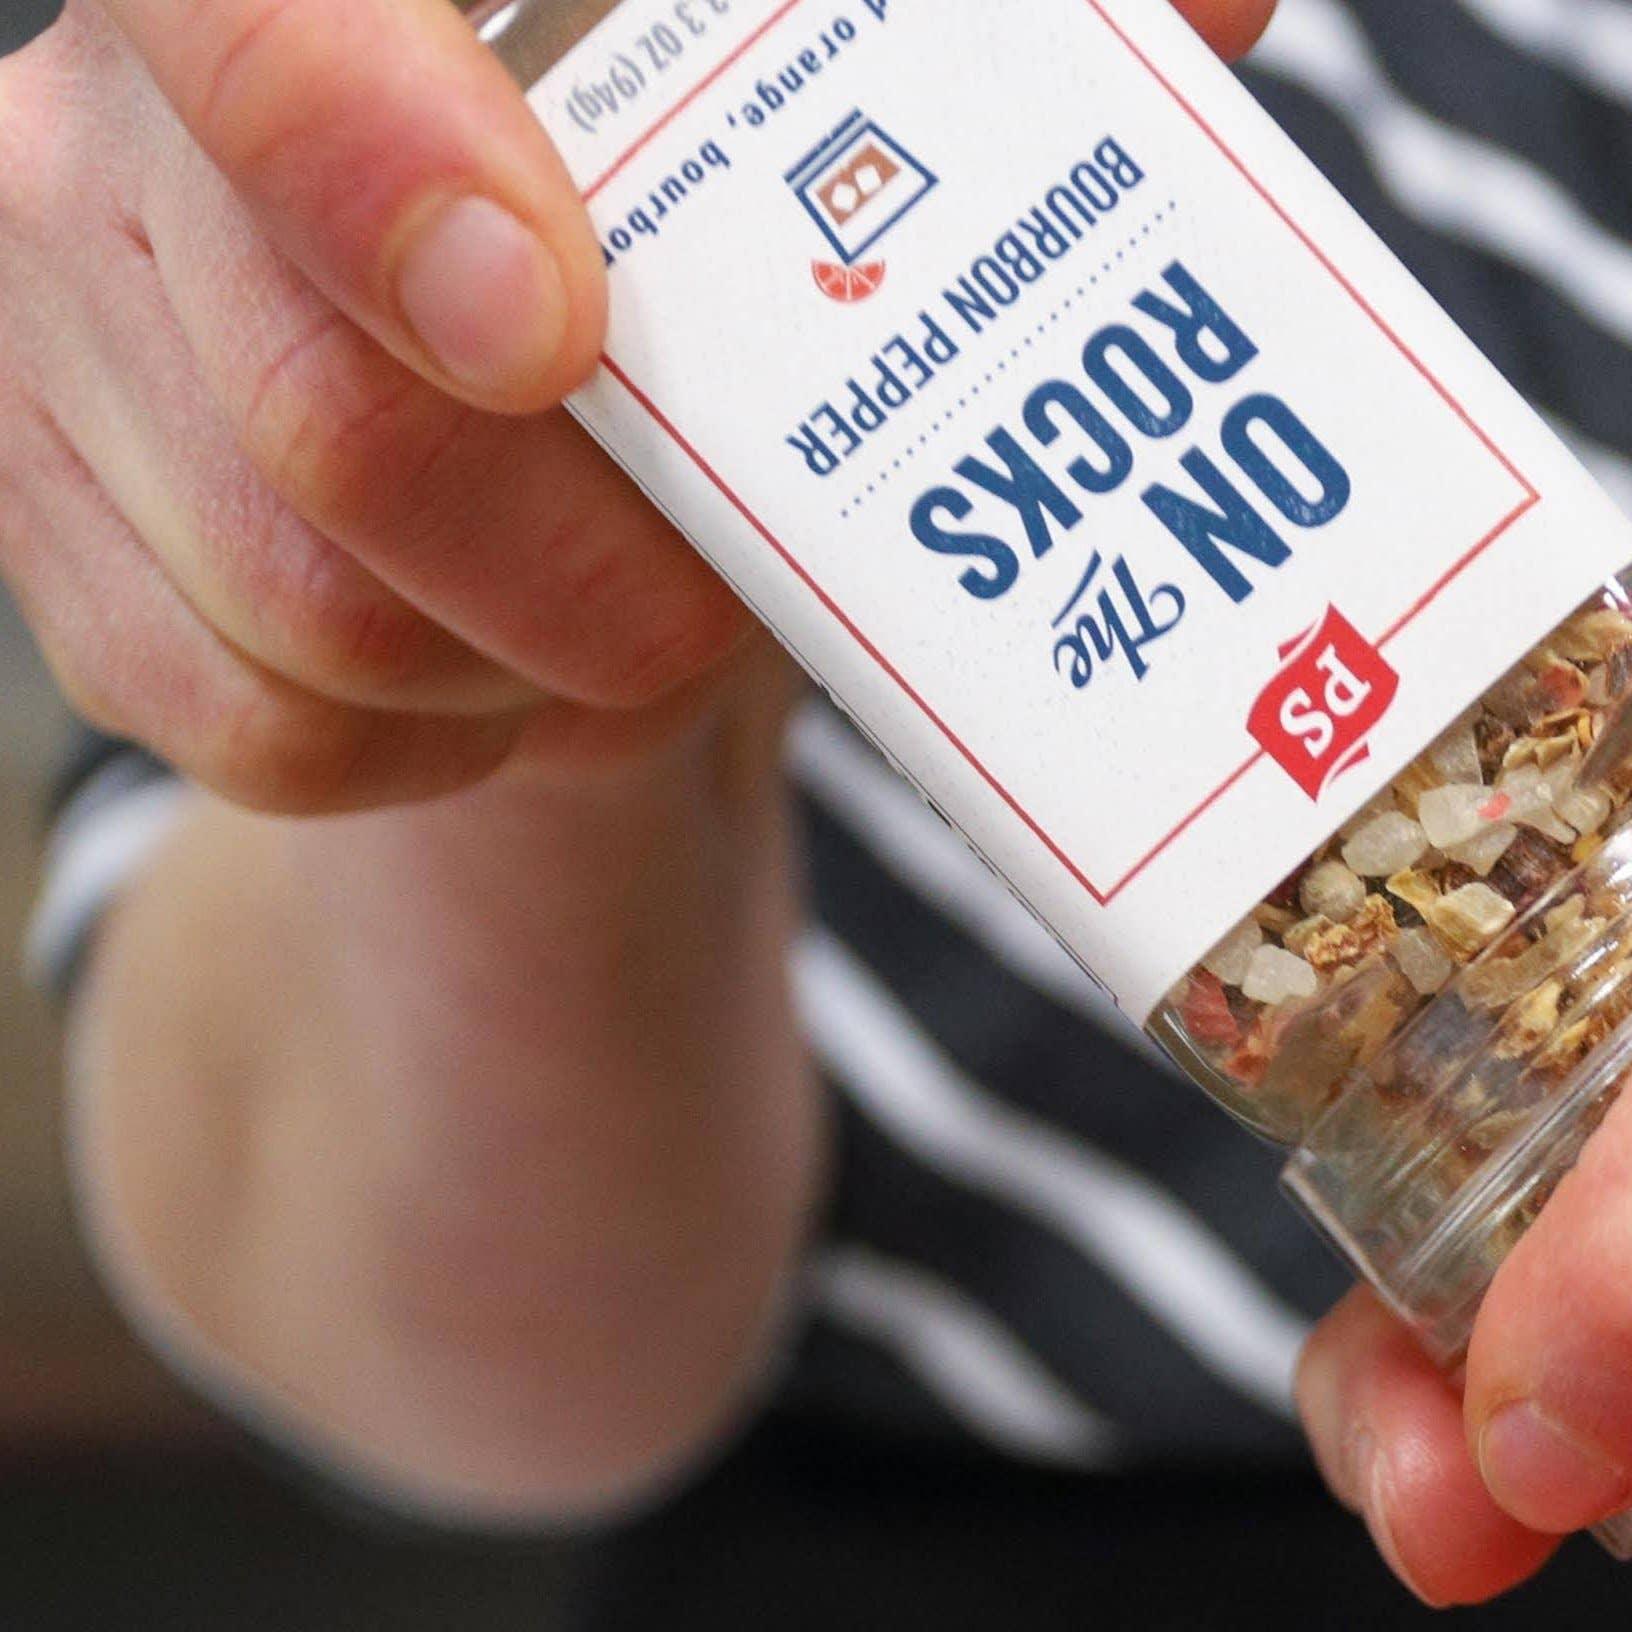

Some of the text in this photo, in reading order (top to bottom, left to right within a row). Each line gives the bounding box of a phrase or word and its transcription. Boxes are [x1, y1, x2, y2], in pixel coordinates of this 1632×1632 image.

[566, 54, 646, 134] (94g)
[635, 21, 684, 70] OZ
[726, 17, 856, 128] orange,
[785, 135, 1145, 476] BOURBON PEPPER
[909, 259, 1259, 600] ROCKS
[1052, 392, 1351, 689] ON The
[1279, 643, 1371, 759] PS
